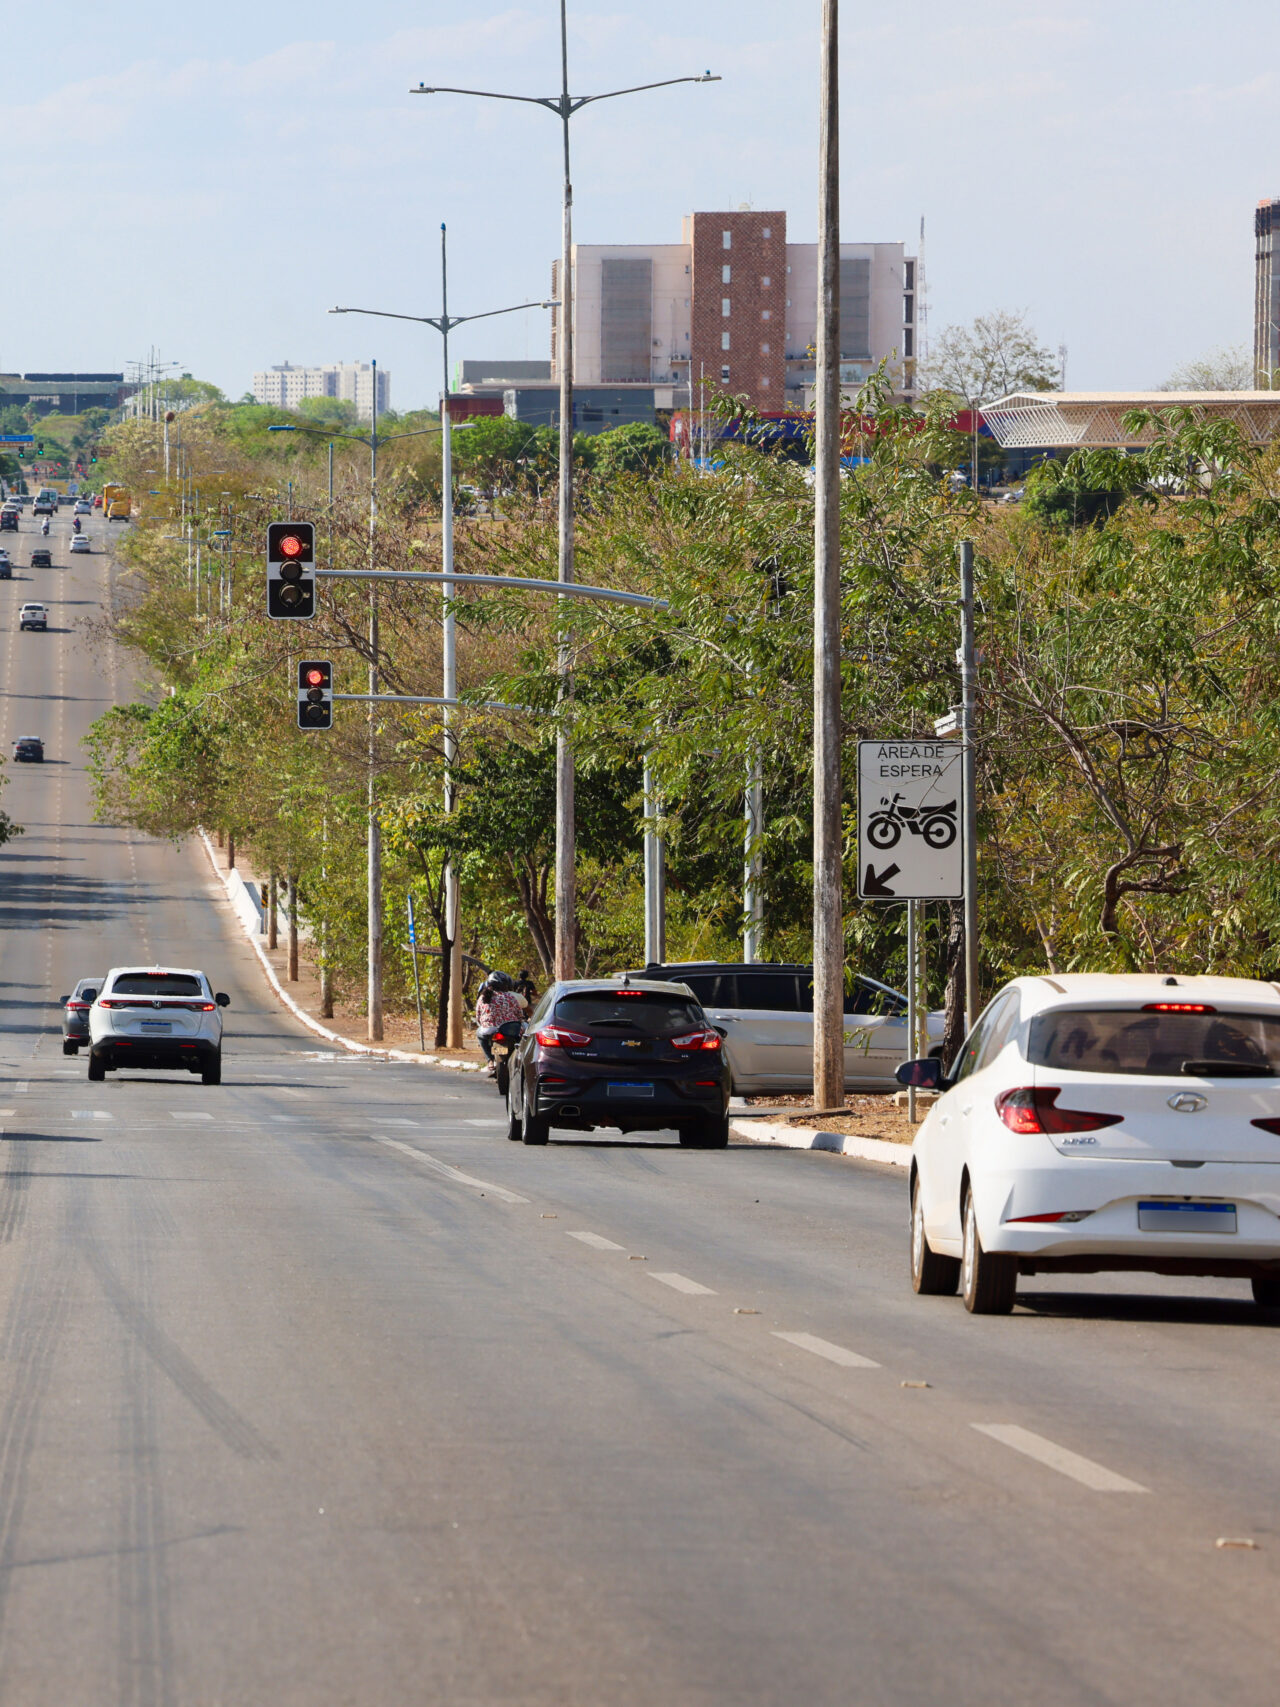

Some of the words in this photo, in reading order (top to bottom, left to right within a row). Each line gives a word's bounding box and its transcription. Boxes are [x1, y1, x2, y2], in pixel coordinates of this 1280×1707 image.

[877, 744, 920, 759] ÁREA
[924, 746, 944, 759] DE
[880, 765, 943, 777] ESPERA
